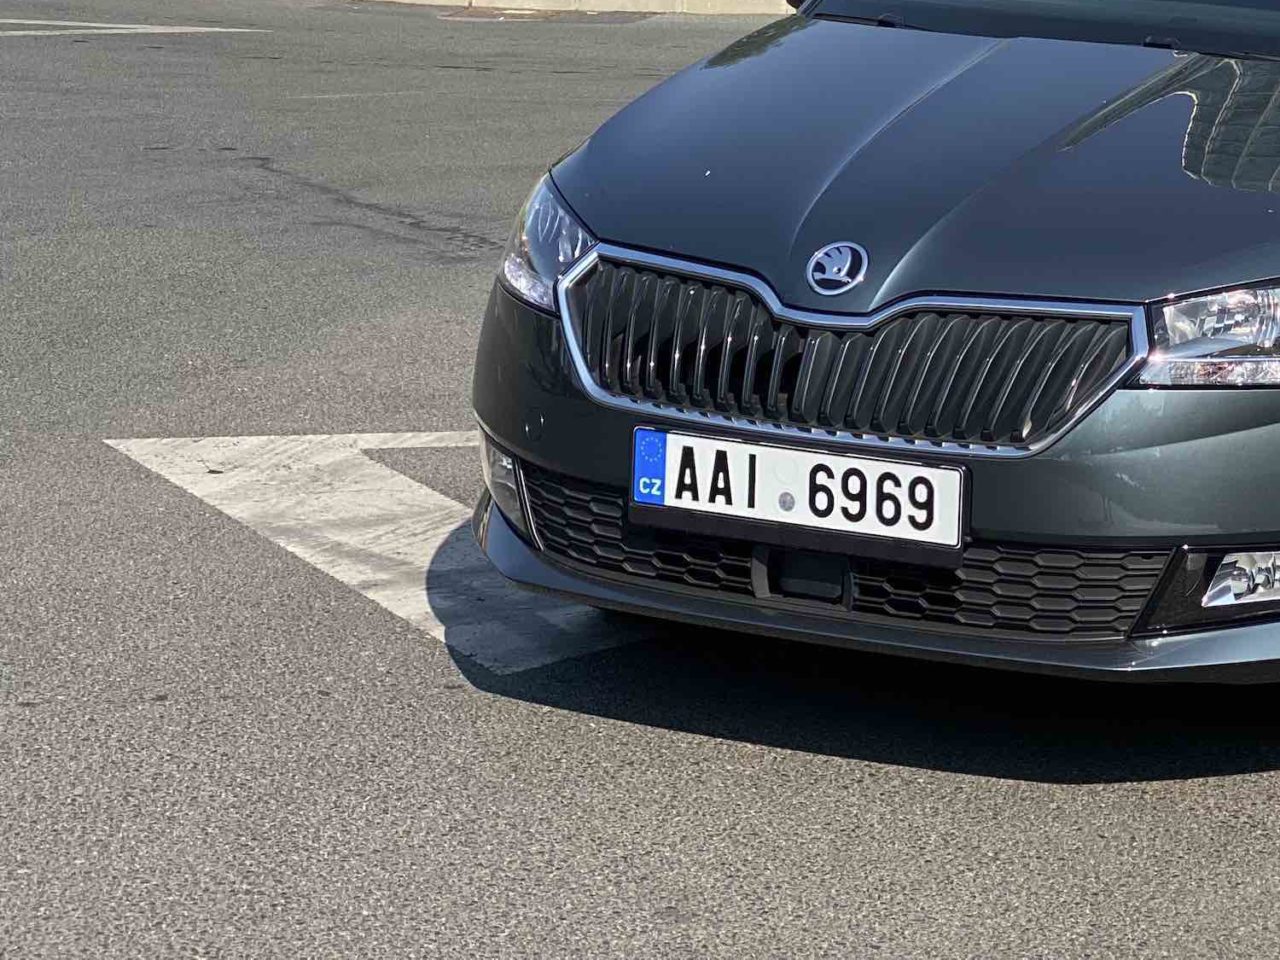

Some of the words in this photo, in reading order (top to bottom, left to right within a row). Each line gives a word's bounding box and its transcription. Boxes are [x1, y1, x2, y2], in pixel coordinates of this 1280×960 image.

[639, 476, 662, 496] CZ
[674, 445, 757, 509] AAI
[808, 463, 935, 531] 6969
